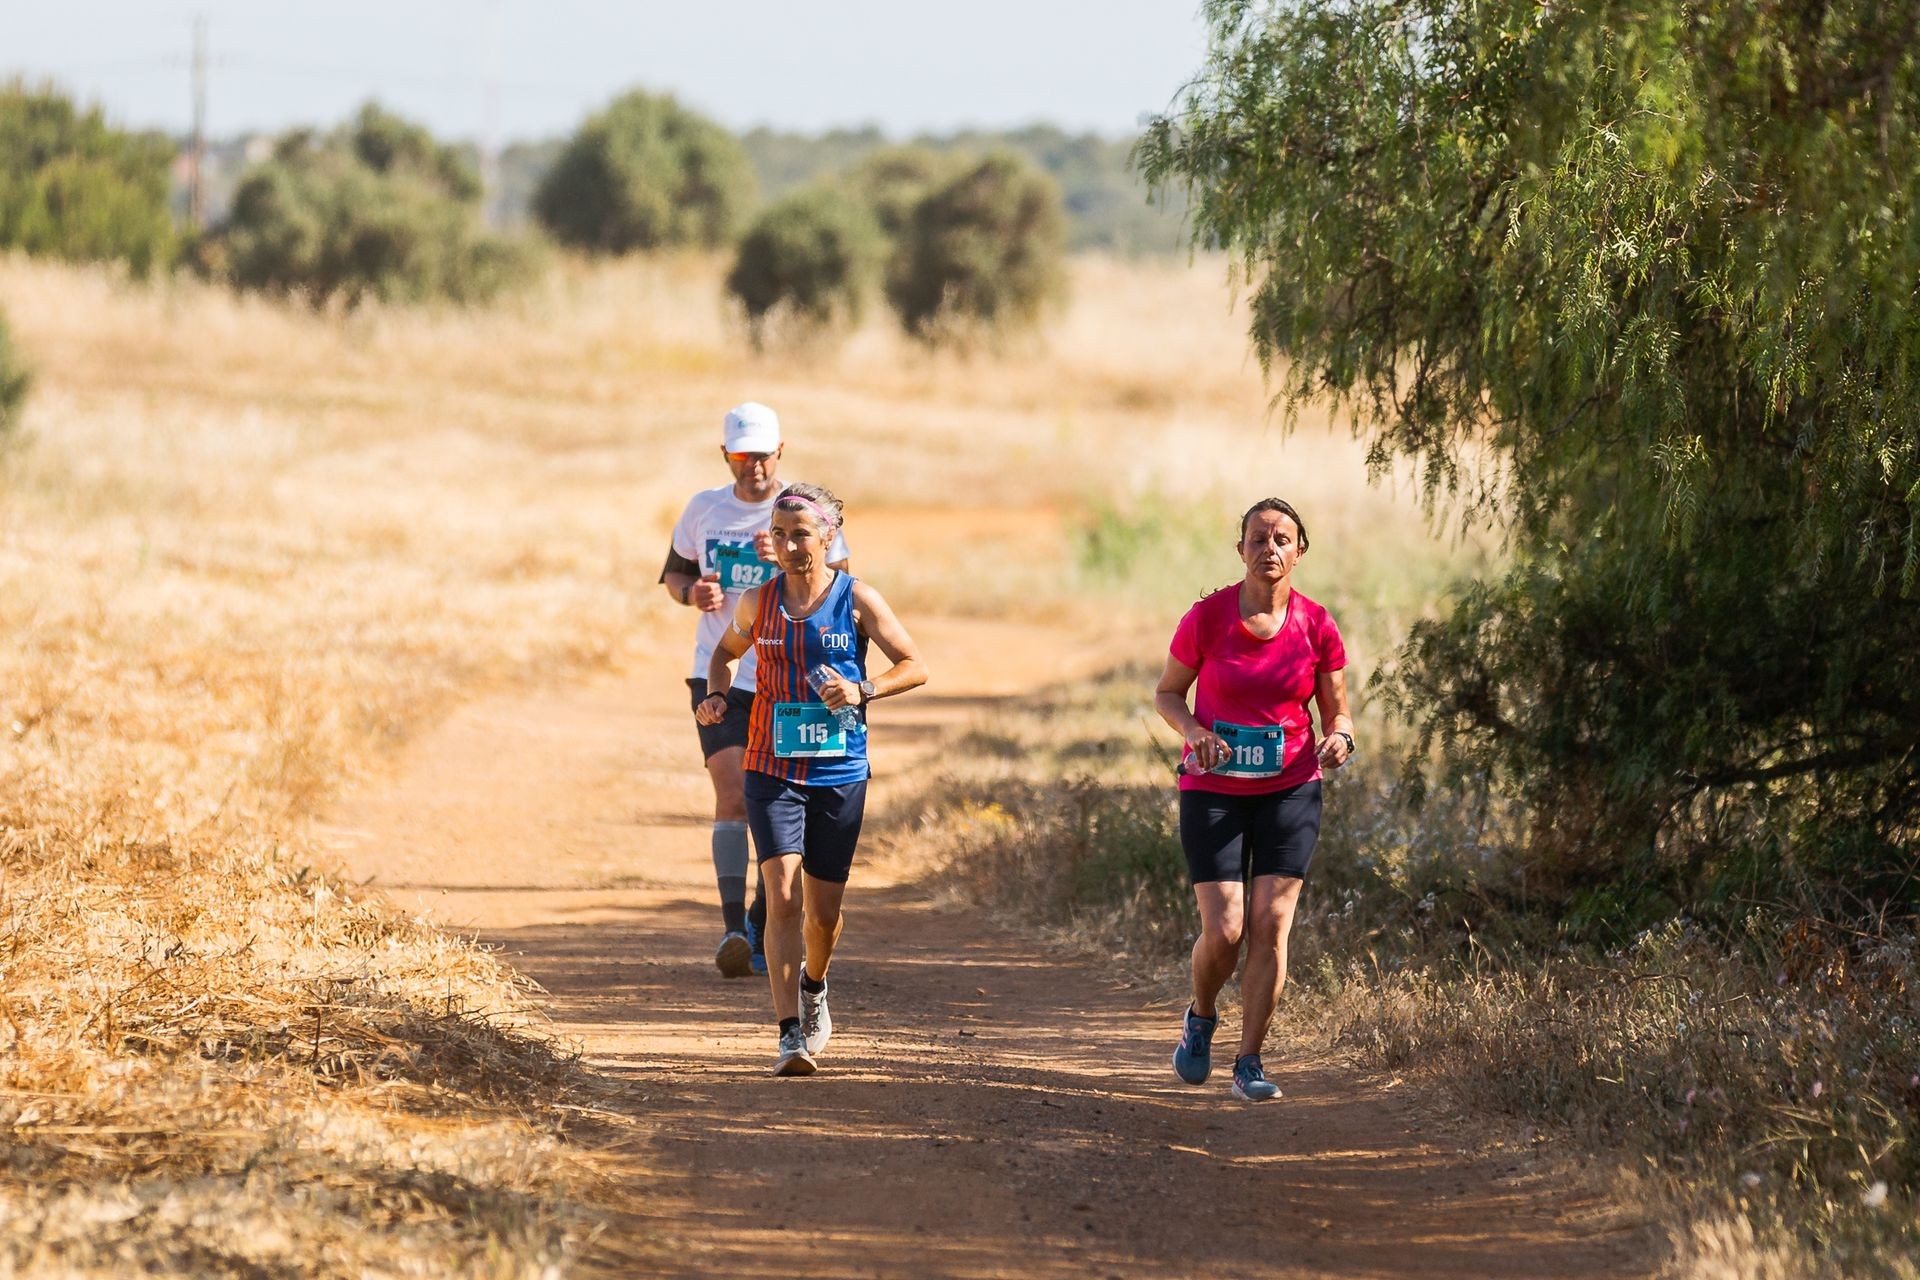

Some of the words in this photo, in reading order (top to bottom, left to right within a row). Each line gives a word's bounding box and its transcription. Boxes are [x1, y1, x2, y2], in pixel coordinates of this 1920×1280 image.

[731, 563, 764, 584] 032
[822, 633, 848, 651] CDQ
[797, 723, 828, 744] 115
[1234, 745, 1264, 766] 118
